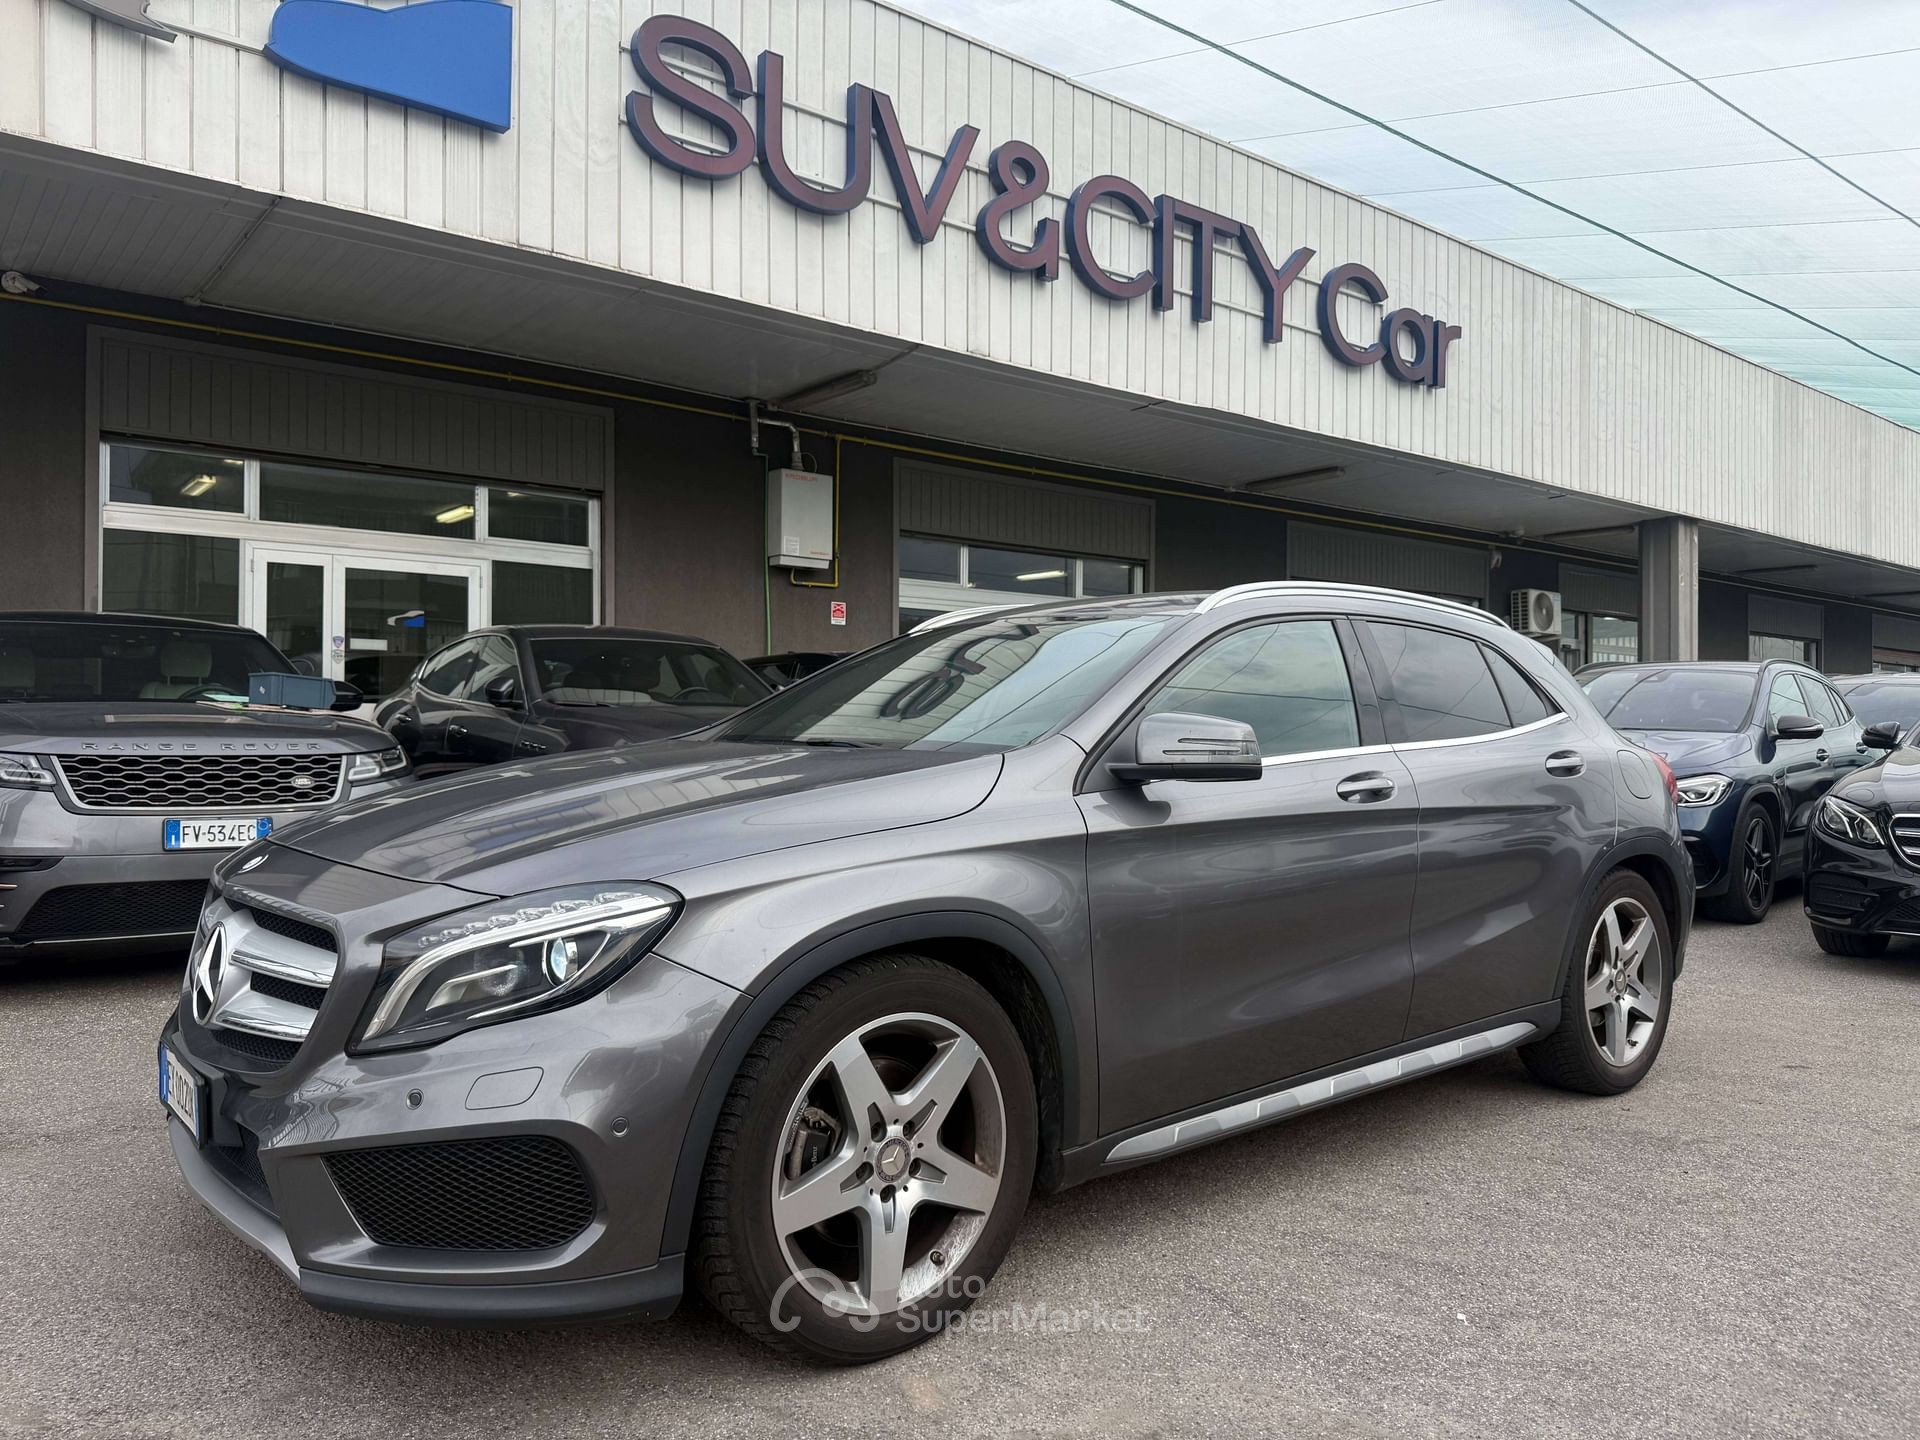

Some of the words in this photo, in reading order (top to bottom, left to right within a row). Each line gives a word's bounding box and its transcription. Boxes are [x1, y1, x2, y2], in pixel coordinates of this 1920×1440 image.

[1318, 262, 1462, 389] Car
[82, 742, 197, 751] RANGE
[221, 742, 321, 750] ROVER
